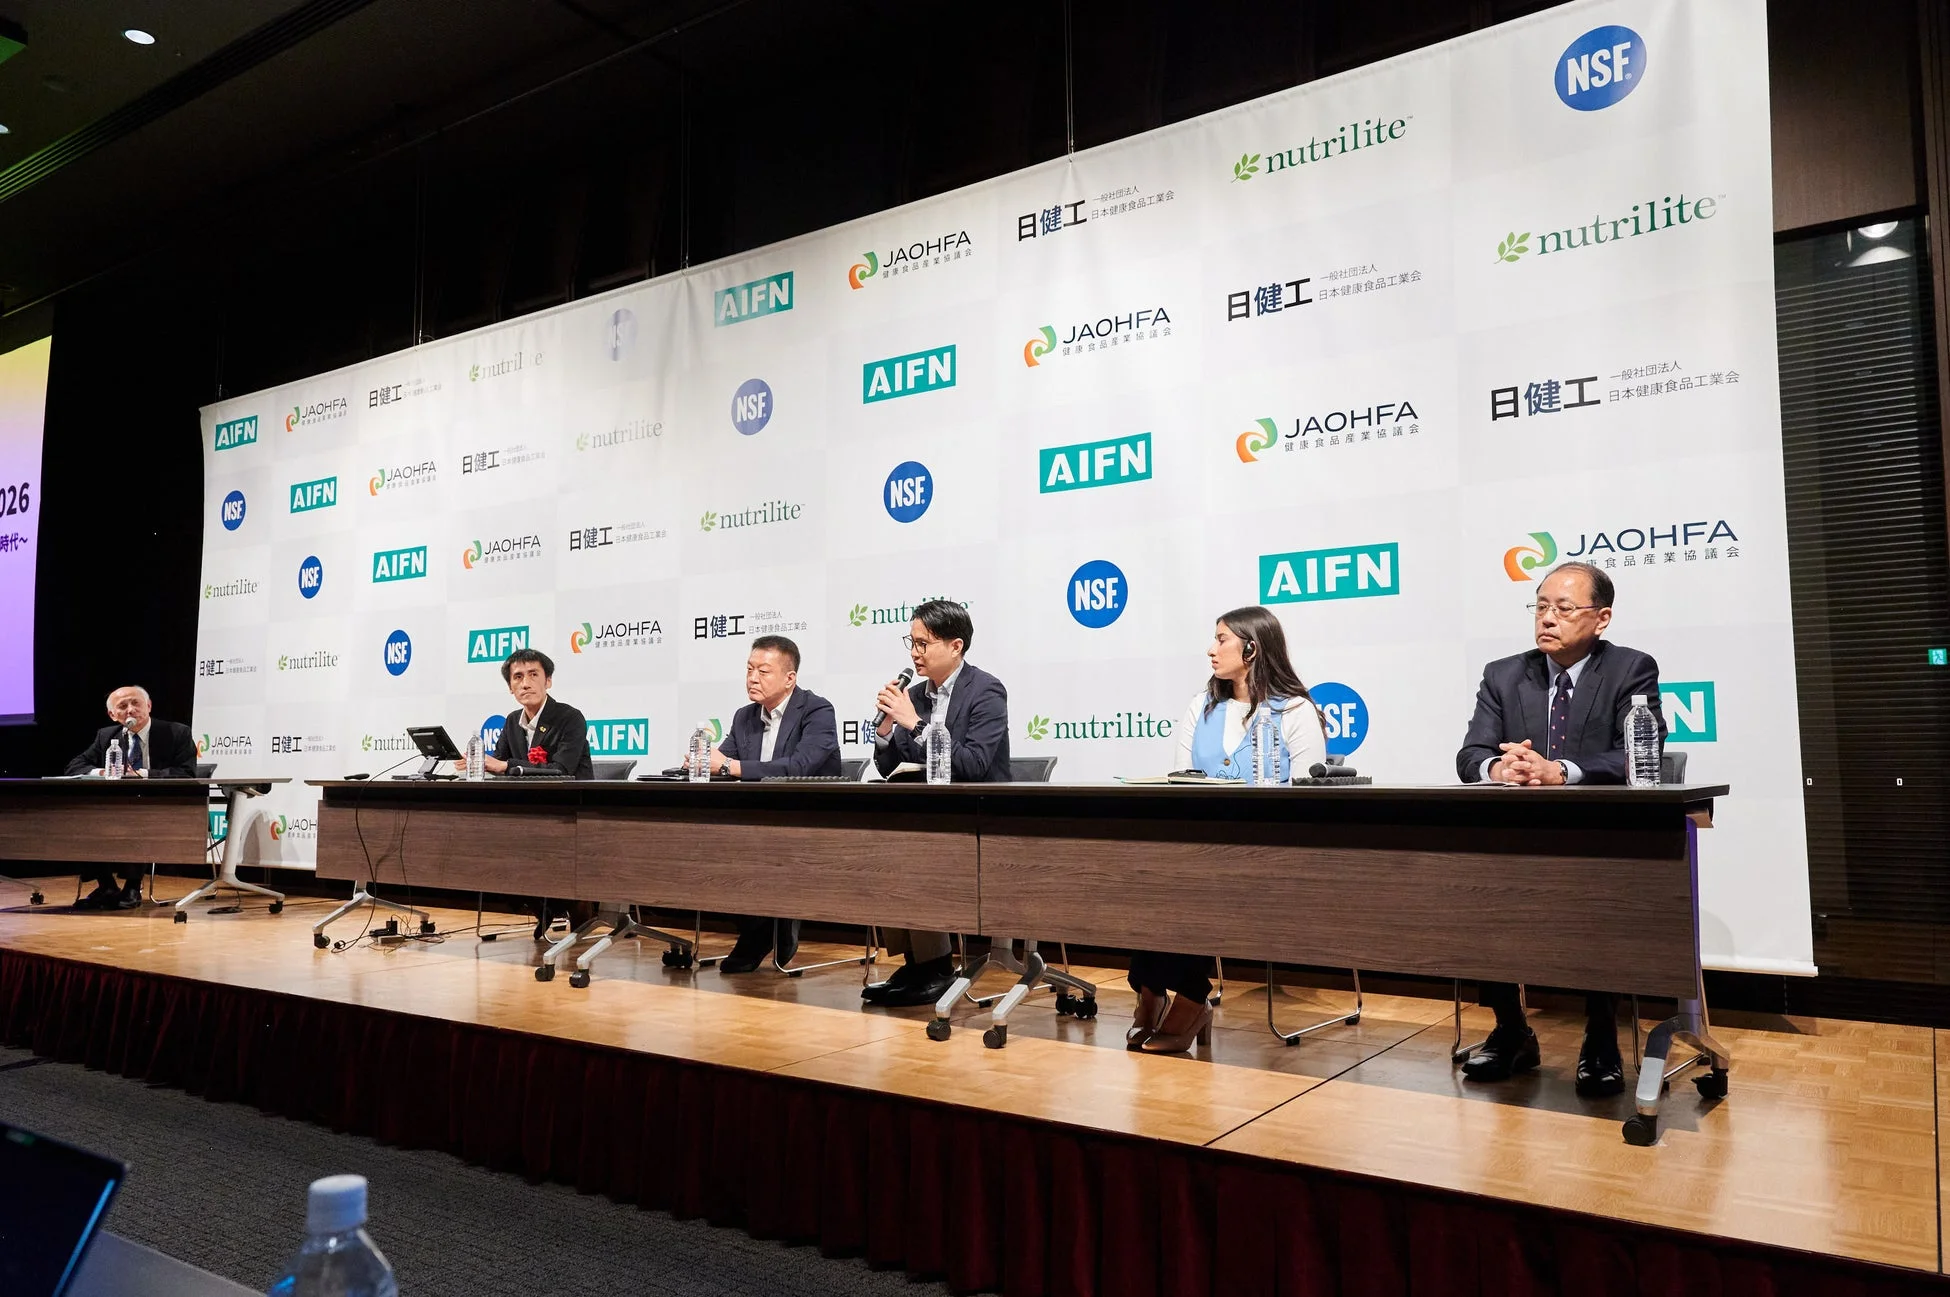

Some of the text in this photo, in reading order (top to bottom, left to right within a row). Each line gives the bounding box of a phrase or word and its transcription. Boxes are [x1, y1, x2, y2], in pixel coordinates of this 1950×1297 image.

[1567, 41, 1632, 96] NSF
[1265, 115, 1407, 174] nutrilite
[1091, 190, 1175, 220] 日本健康食品工業会
[1093, 185, 1140, 202] 一般社団法人
[1018, 200, 1087, 241] 日健工
[1537, 194, 1717, 256] nutrilite
[883, 230, 971, 268] JAOHFA
[1319, 269, 1422, 301] 日本健康食品工業会
[1320, 264, 1378, 281] 一般社団法人
[720, 278, 789, 321] AIFN
[1228, 277, 1312, 321] 日健工
[1063, 307, 1170, 344] JAOHFA
[1062, 327, 1172, 357] 健康食品産業協議会
[482, 352, 543, 379] nutrile
[868, 352, 951, 397] AIFN
[1609, 360, 1682, 381] 一般社団法人
[369, 384, 402, 408] 日健工
[1491, 376, 1601, 421] 日健工
[1608, 370, 1740, 402] 日本健康食品工業会
[302, 397, 347, 419] JAOHFA
[736, 391, 767, 422] NSF
[1284, 401, 1419, 439] JAOHFA
[216, 419, 256, 447] AIFN
[592, 419, 662, 448] nutrilite
[1284, 423, 1419, 453] 健康食品産業協議会
[387, 461, 437, 482] JAOHFA
[462, 450, 500, 475] 日健工
[1045, 439, 1147, 487] AIFN
[292, 481, 335, 509] AIFN
[890, 476, 925, 508] NSF
[224, 500, 242, 521] NSF
[720, 500, 801, 530] nutrilite
[484, 535, 542, 555] JAOHFA
[569, 527, 613, 551] 日健工
[1567, 519, 1738, 557] JAOHFA
[301, 566, 320, 589] NSF
[375, 550, 424, 579] AIFN
[1267, 551, 1391, 597] AIFN
[213, 579, 258, 598] nutrilite
[1074, 576, 1118, 612] NSF
[595, 620, 662, 639] JAOHFA
[694, 613, 745, 640] 日健工
[387, 640, 408, 665] NSF
[471, 631, 526, 658] AIFN
[289, 651, 338, 670] nutrilite
[586, 723, 645, 751] AIFN
[843, 719, 877, 745] 日健
[1053, 711, 1172, 739] nutrilite
[211, 736, 252, 748] JAOHFA
[272, 735, 302, 754] 日健工
[374, 732, 420, 751] nutril
[483, 728, 502, 751] NS
[288, 818, 317, 831] JAOH
